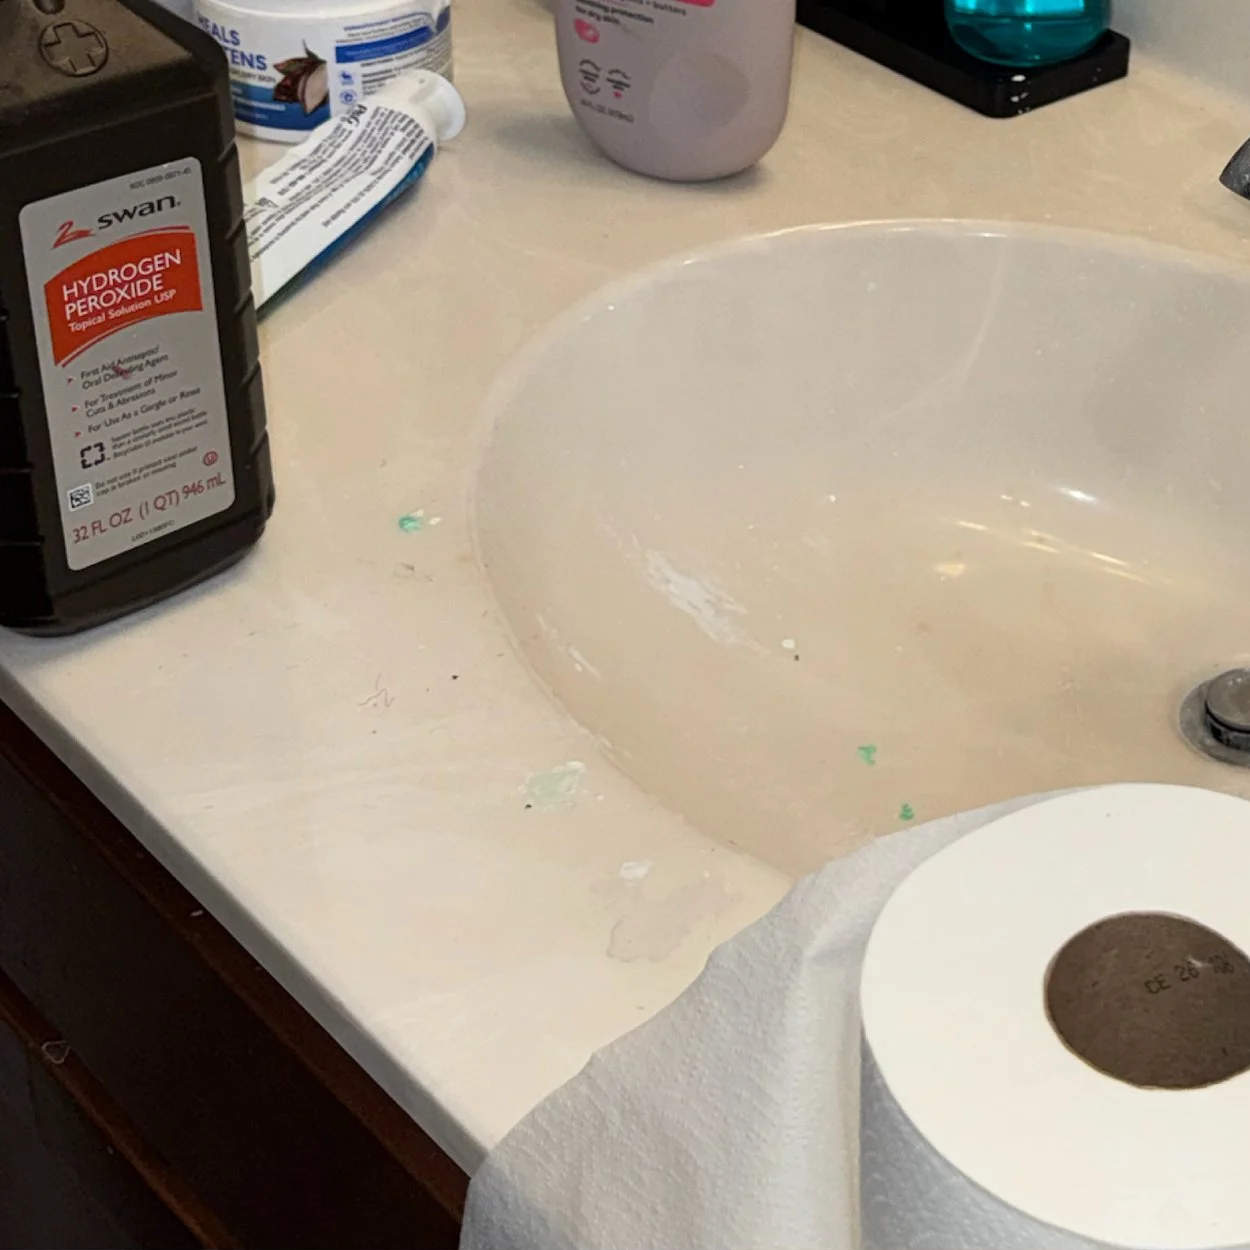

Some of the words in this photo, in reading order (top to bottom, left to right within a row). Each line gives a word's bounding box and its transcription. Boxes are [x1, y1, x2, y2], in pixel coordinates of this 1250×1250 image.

[229, 47, 268, 71] ENS
[62, 248, 182, 301] HYDROGEN
[65, 273, 164, 321] PEROXIDE
[68, 312, 105, 333] Topical
[109, 299, 150, 319] Solution
[154, 289, 176, 304] USP
[84, 396, 99, 408] For
[144, 377, 153, 388] of
[104, 364, 144, 384] Deding
[88, 421, 102, 433] For
[104, 415, 120, 428] Use
[121, 412, 132, 422] As
[72, 525, 89, 544] 32
[91, 520, 107, 536] FL
[109, 507, 134, 528] OZ
[153, 490, 180, 512] QT)
[182, 479, 205, 499] 946
[206, 472, 226, 489] mL
